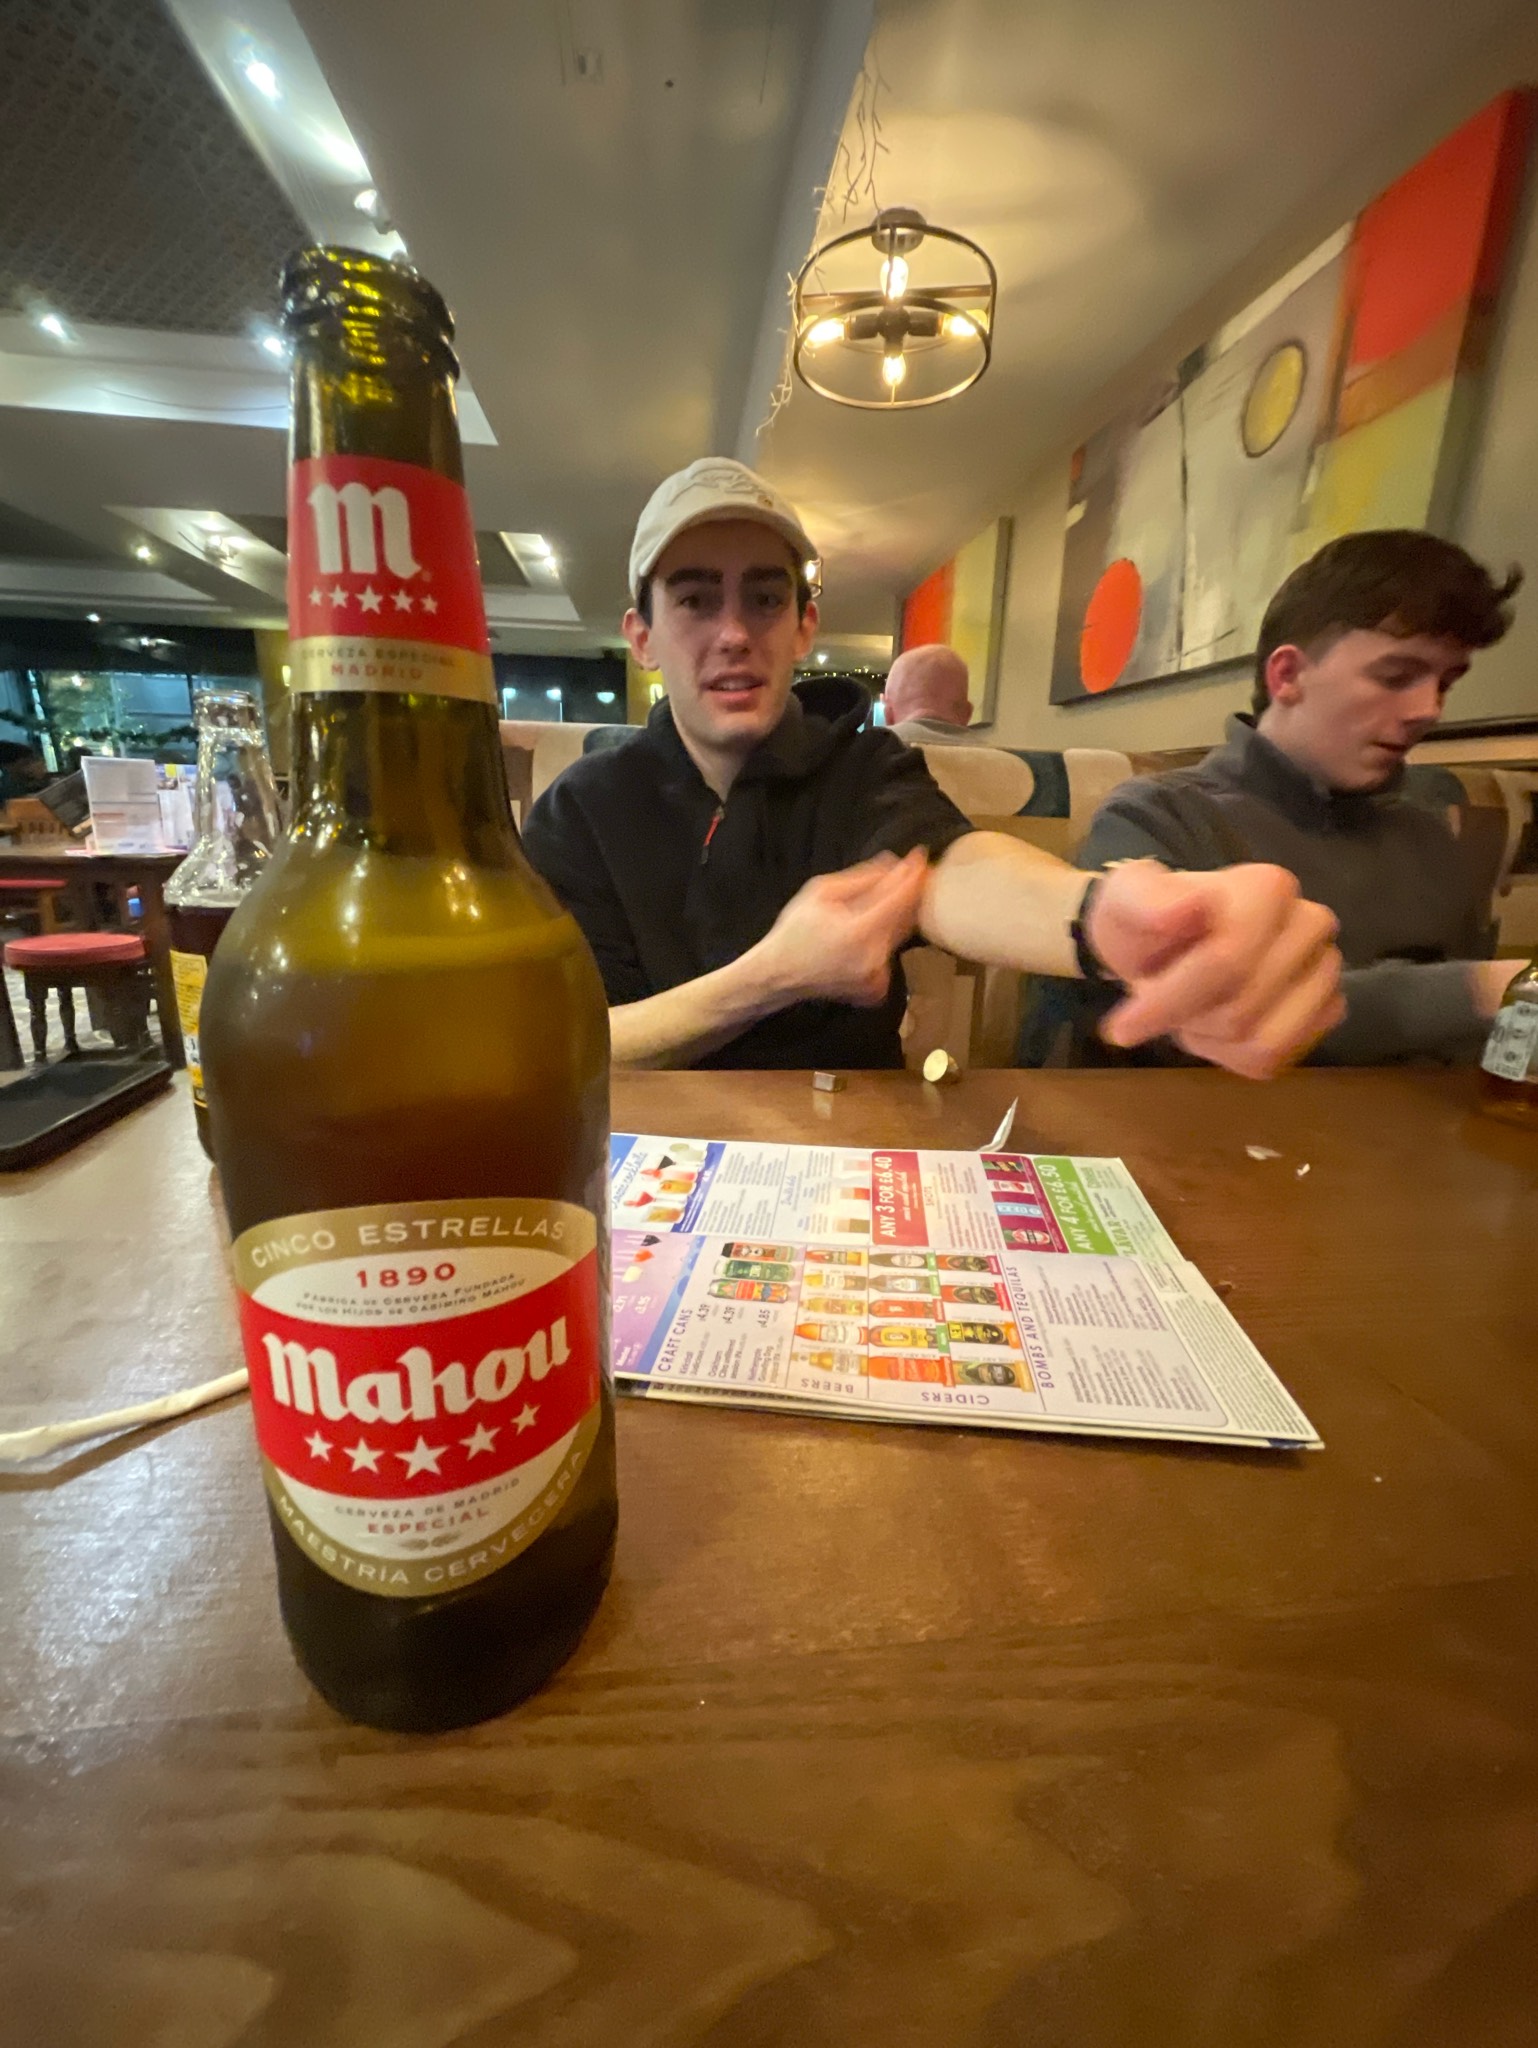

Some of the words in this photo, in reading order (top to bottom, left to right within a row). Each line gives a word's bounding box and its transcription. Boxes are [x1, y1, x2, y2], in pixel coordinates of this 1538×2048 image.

[331, 664, 423, 681] MADRID
[874, 1156, 894, 1184] £6.40
[1038, 1164, 1068, 1194] £6.50
[879, 1185, 895, 1204] FOR
[1055, 1194, 1078, 1215] FOR
[874, 1205, 896, 1214] 3
[1058, 1215, 1080, 1225] 4
[880, 1215, 897, 1238] ANY
[250, 1230, 337, 1269] CINCO
[357, 1216, 566, 1247] ESTRELLAS
[1069, 1227, 1095, 1251] ANY
[355, 1262, 457, 1289] 1890
[454, 1273, 516, 1295] FUNDADA
[481, 1278, 527, 1300] MAHOU
[1005, 1266, 1031, 1312] TEQUILAS
[1021, 1315, 1039, 1340] AND
[657, 1337, 683, 1372] CRAFT
[672, 1308, 693, 1336] CANS
[1029, 1345, 1055, 1389] BOMBS
[800, 1376, 855, 1395] BEERS
[921, 1390, 991, 1406] CIDERS
[335, 1505, 414, 1519] CERVEZA
[424, 1505, 445, 1516] DE
[453, 1477, 520, 1509] MADRID
[279, 1494, 411, 1585] MAESTRÍA
[422, 1448, 584, 1584] CERVECERA
[367, 1508, 490, 1535] ESPECIAL
